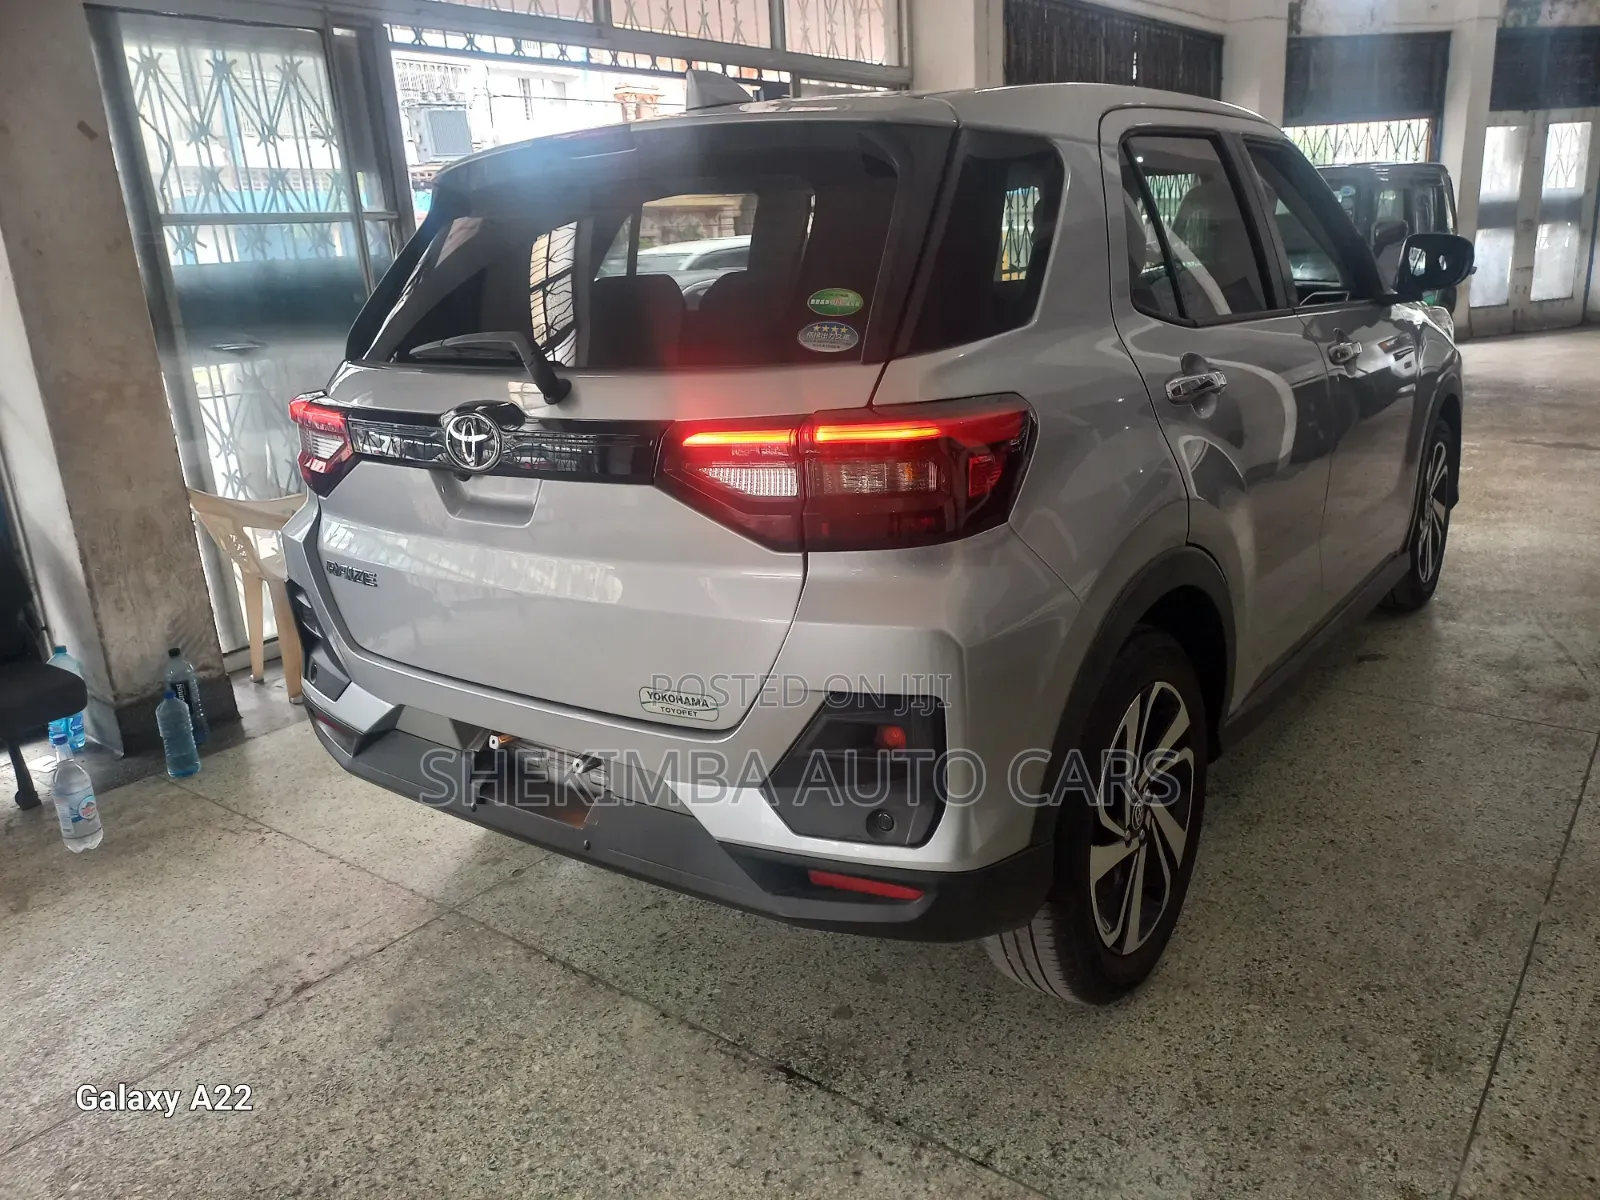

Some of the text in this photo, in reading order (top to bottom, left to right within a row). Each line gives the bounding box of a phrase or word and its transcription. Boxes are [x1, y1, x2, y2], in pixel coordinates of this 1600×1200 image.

[326, 560, 378, 587] RAIZE
[646, 690, 710, 708] YOKOHAMA
[660, 706, 698, 717] TOYOPET
